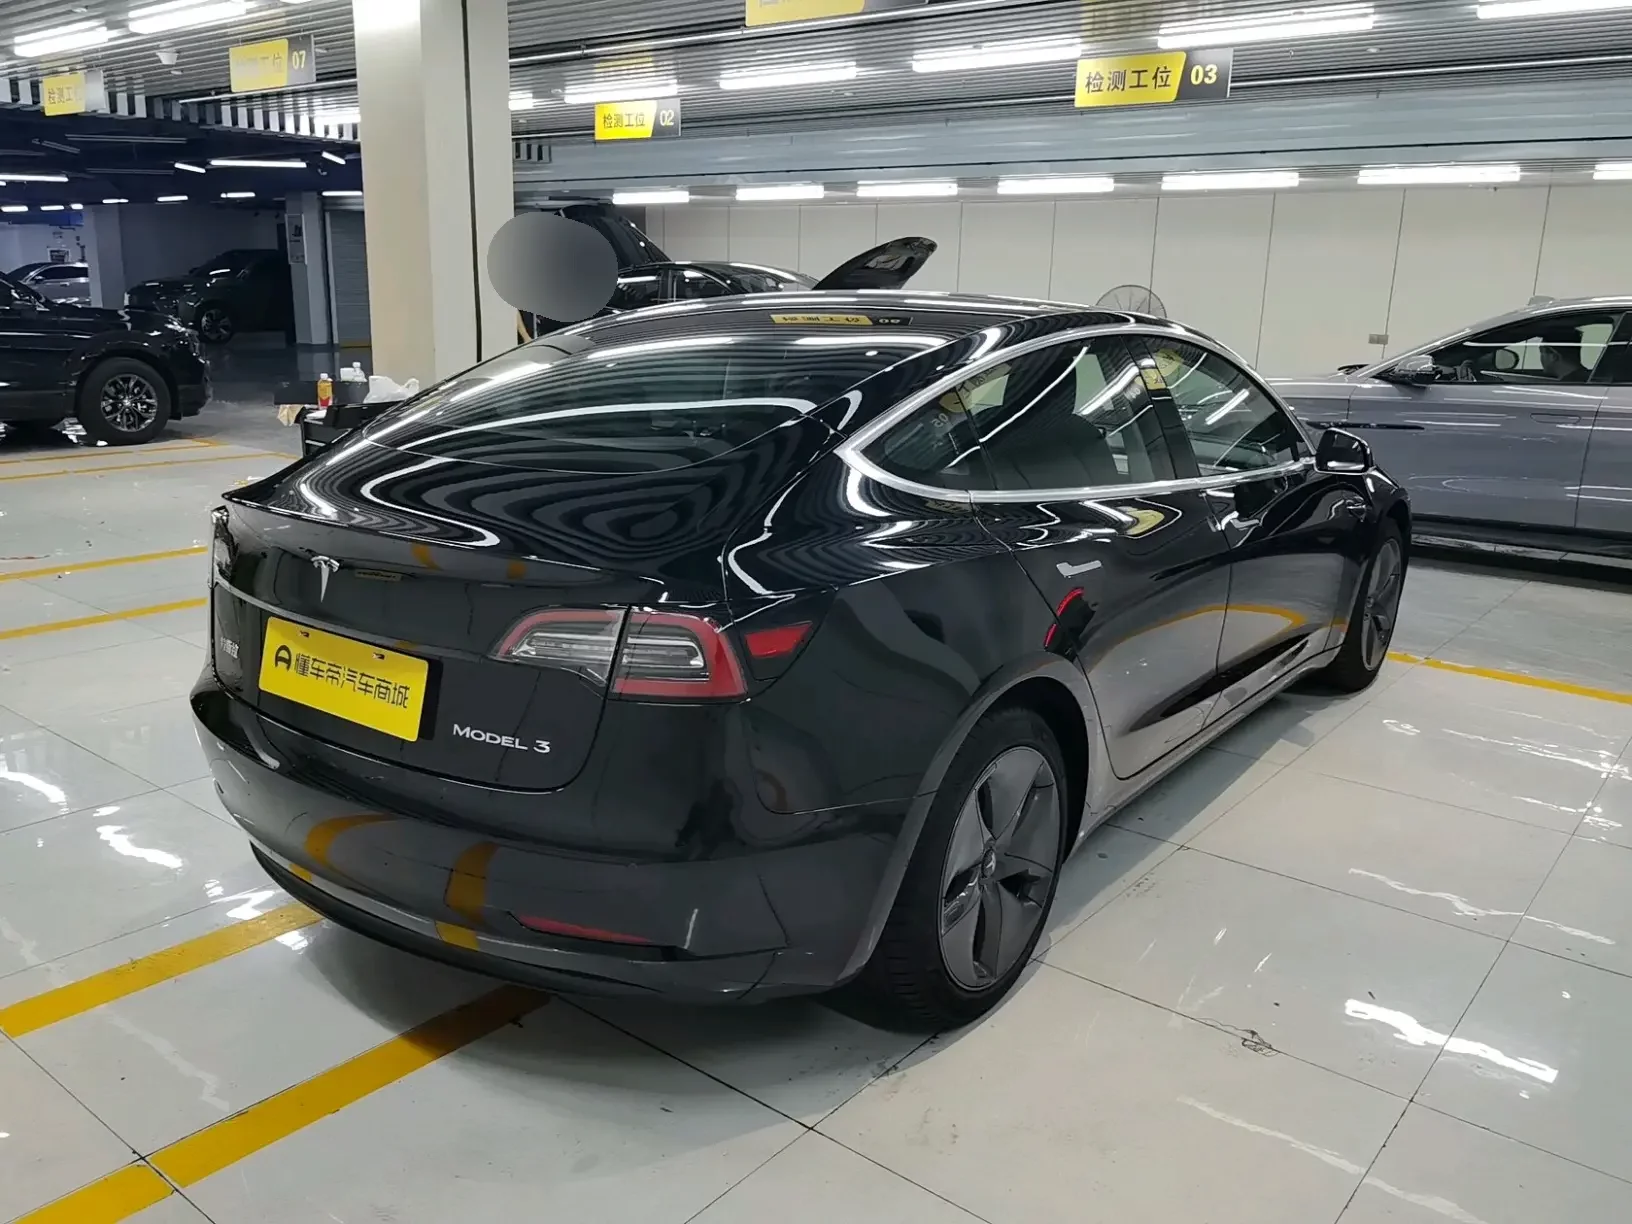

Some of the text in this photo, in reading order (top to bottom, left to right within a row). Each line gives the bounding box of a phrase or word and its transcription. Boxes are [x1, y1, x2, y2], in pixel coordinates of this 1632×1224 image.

[292, 50, 306, 70] 07
[1085, 64, 1218, 94] 检测工位 03
[603, 109, 675, 129] 检测工位 02
[294, 652, 410, 709] 懂车帝汽车商城
[453, 723, 551, 753] MODEL 3
